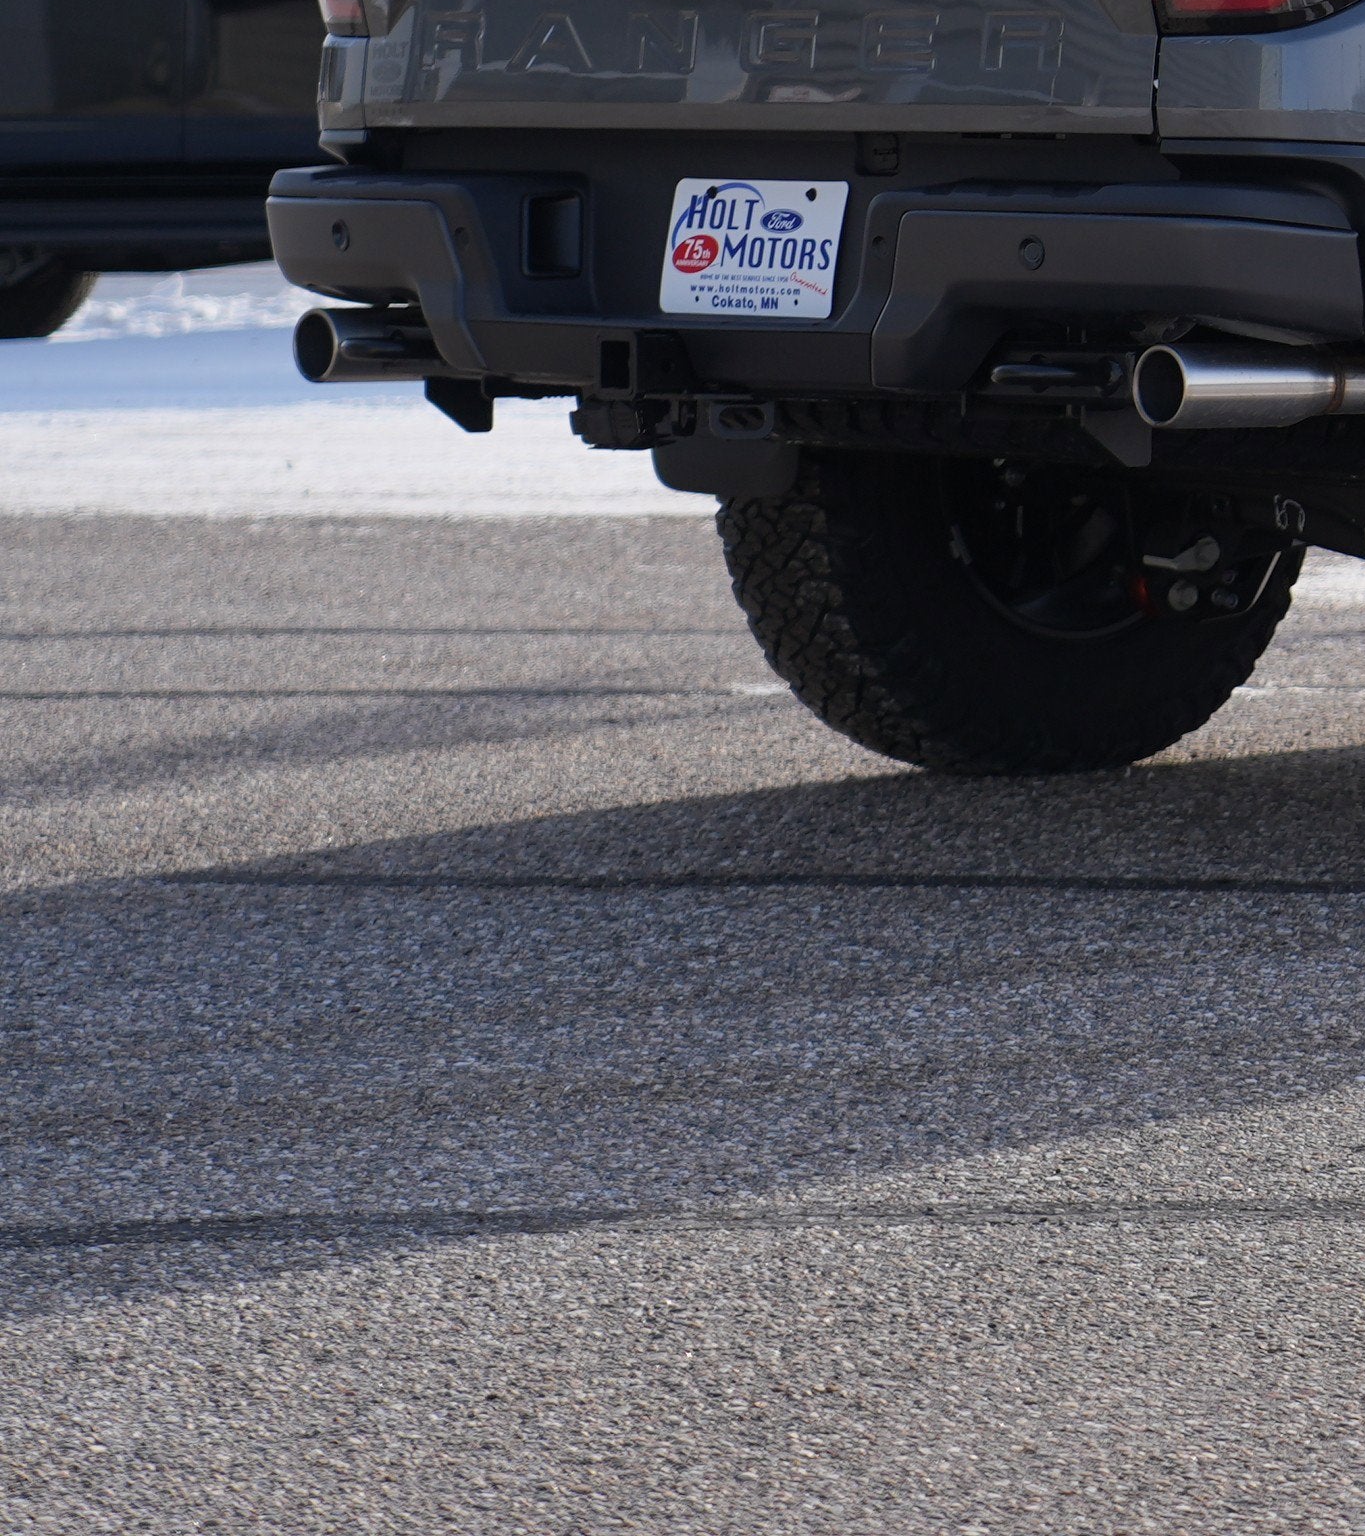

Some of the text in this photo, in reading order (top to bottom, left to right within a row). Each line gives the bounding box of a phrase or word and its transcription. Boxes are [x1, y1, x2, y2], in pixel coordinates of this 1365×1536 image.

[421, 8, 1066, 73] RANGER
[686, 195, 760, 231] HOLT
[766, 210, 796, 231] Ford
[683, 239, 711, 259] 75th
[720, 233, 833, 270] MOTORS
[690, 283, 800, 295] www.holtmotors.com
[712, 295, 779, 312] Cokato, MN
